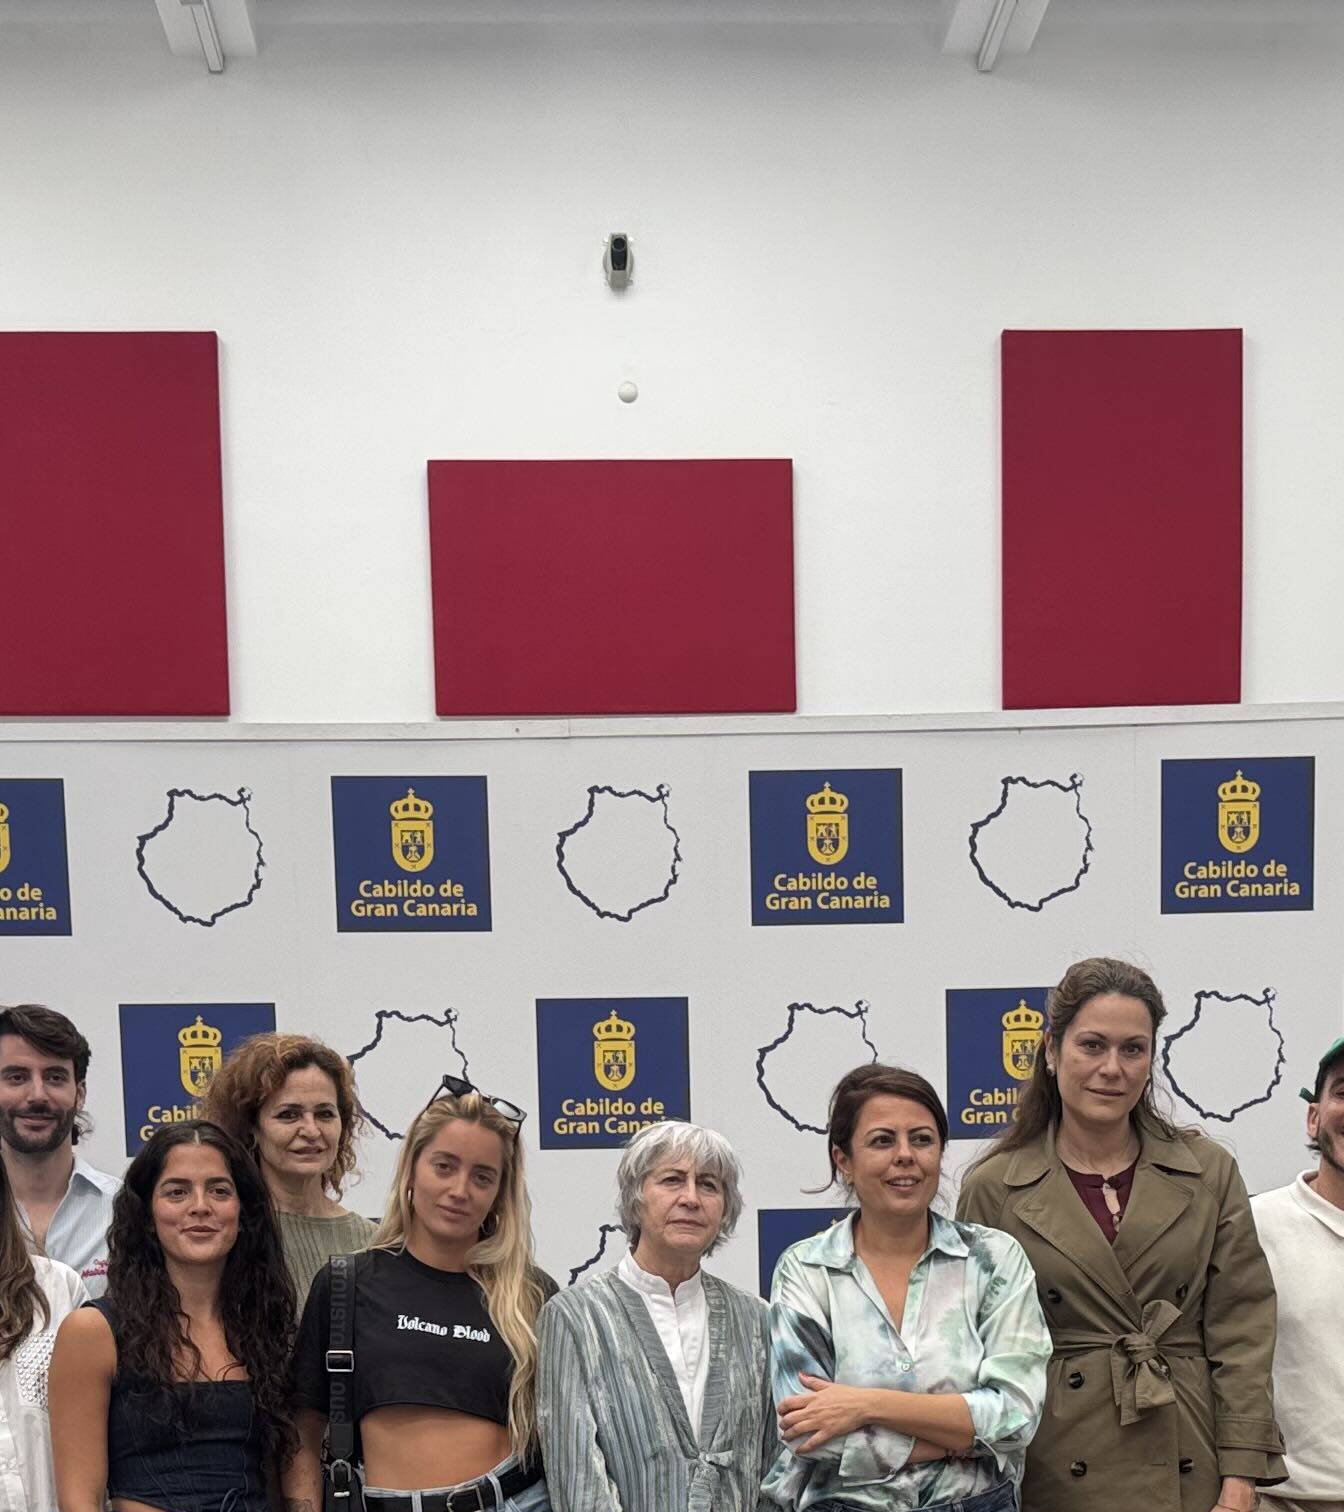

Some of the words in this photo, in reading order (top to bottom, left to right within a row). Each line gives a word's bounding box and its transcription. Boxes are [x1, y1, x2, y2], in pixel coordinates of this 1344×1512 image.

[1184, 861, 1259, 880] Cabildo
[1263, 860, 1288, 878] de
[16, 881, 43, 901] de
[359, 880, 434, 898] Cabildo
[438, 879, 464, 898] de
[773, 873, 849, 891] Cabildo
[852, 873, 877, 890] de
[1174, 881, 1222, 899] Gran
[1226, 879, 1300, 897] Canaria
[351, 900, 399, 917] Gran
[402, 899, 478, 917] Canaria
[765, 893, 812, 910] Gran
[816, 891, 891, 910] Canaria
[969, 1087, 1020, 1106] Cabil
[147, 1104, 199, 1123] Cabil
[561, 1098, 636, 1116] Cabildo
[639, 1098, 664, 1115] de
[960, 1107, 1008, 1125] Gran
[553, 1117, 600, 1134] Gran
[396, 1313, 448, 1337] Volcano
[451, 1324, 492, 1344] Blood
